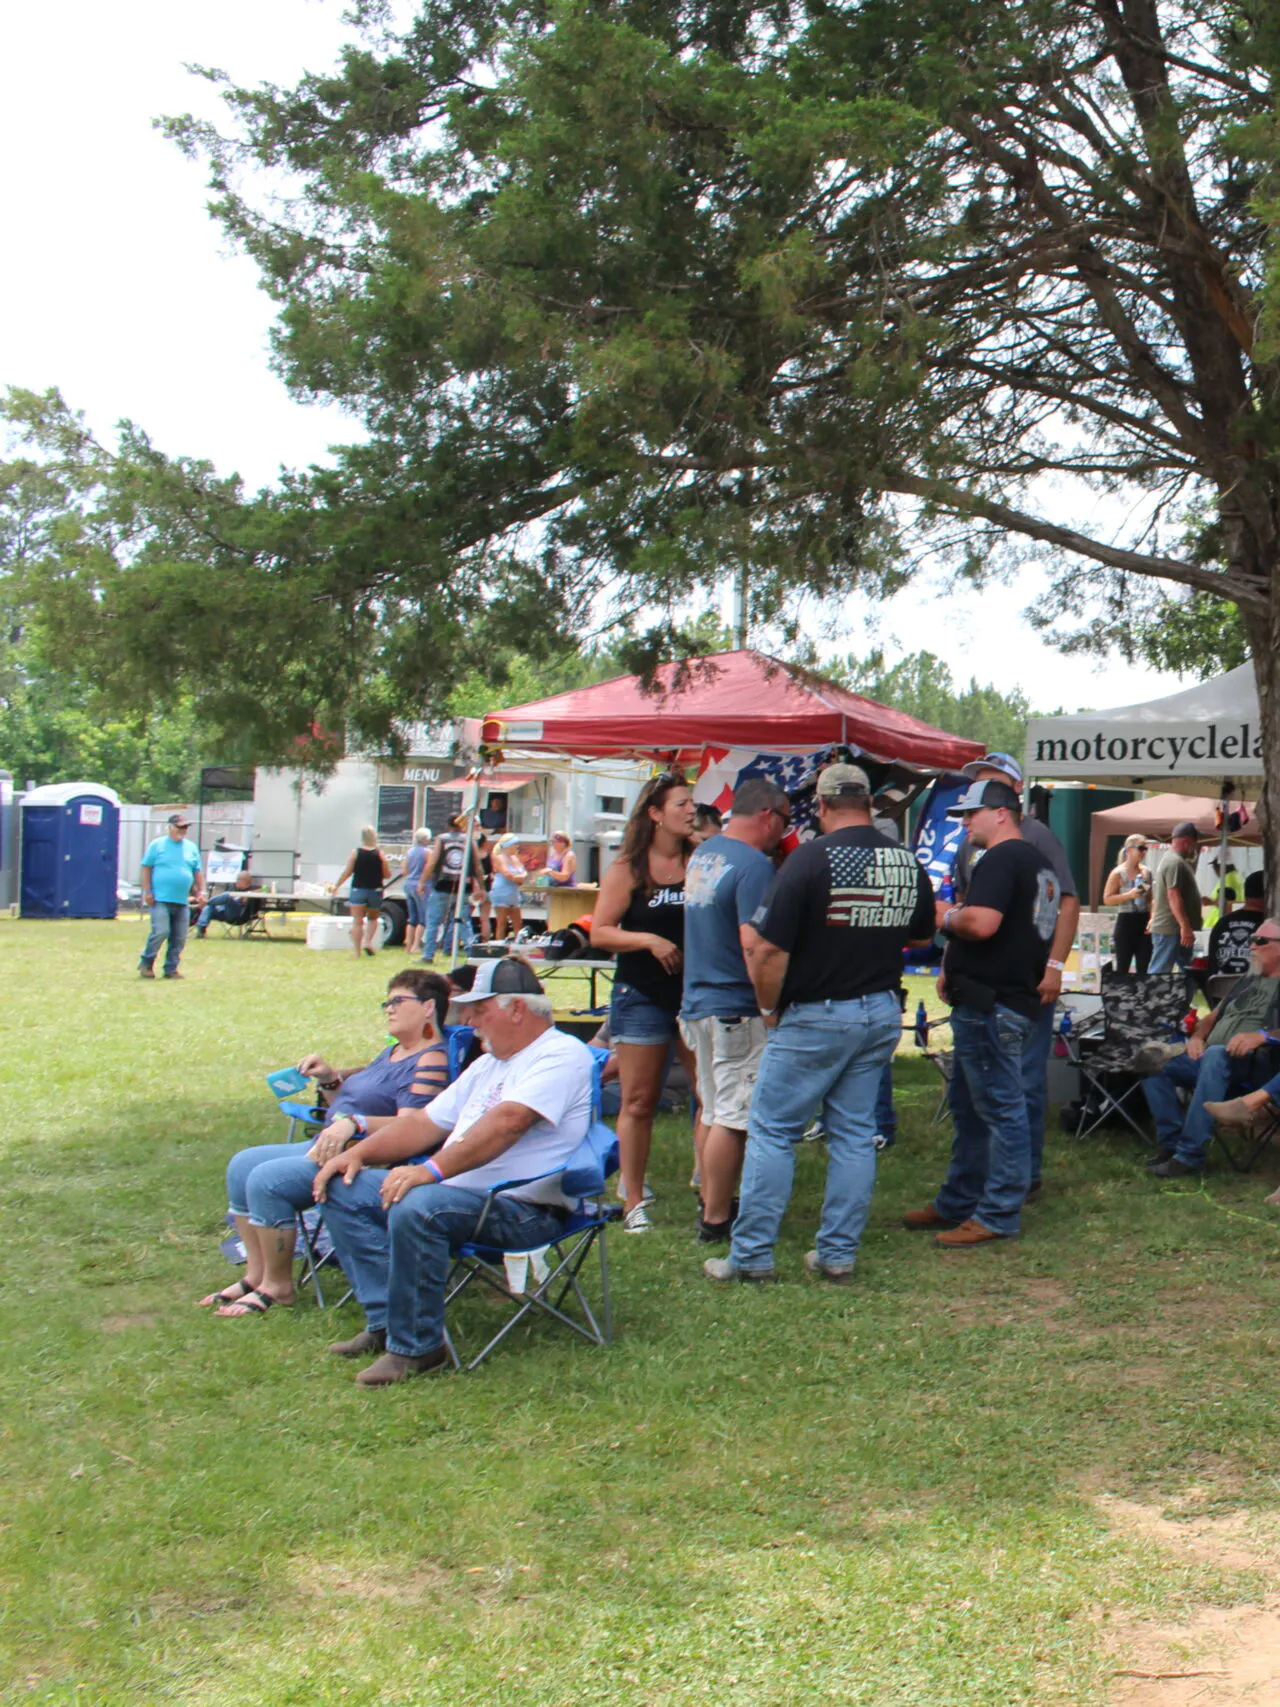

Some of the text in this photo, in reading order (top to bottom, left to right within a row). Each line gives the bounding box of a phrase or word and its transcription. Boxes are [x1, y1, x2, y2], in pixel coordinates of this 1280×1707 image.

[403, 768, 441, 782] MENU
[874, 847, 918, 868] FAITH
[865, 866, 919, 887] FAMILY
[883, 886, 919, 908] FLAG
[849, 906, 915, 927] FREEDOM
